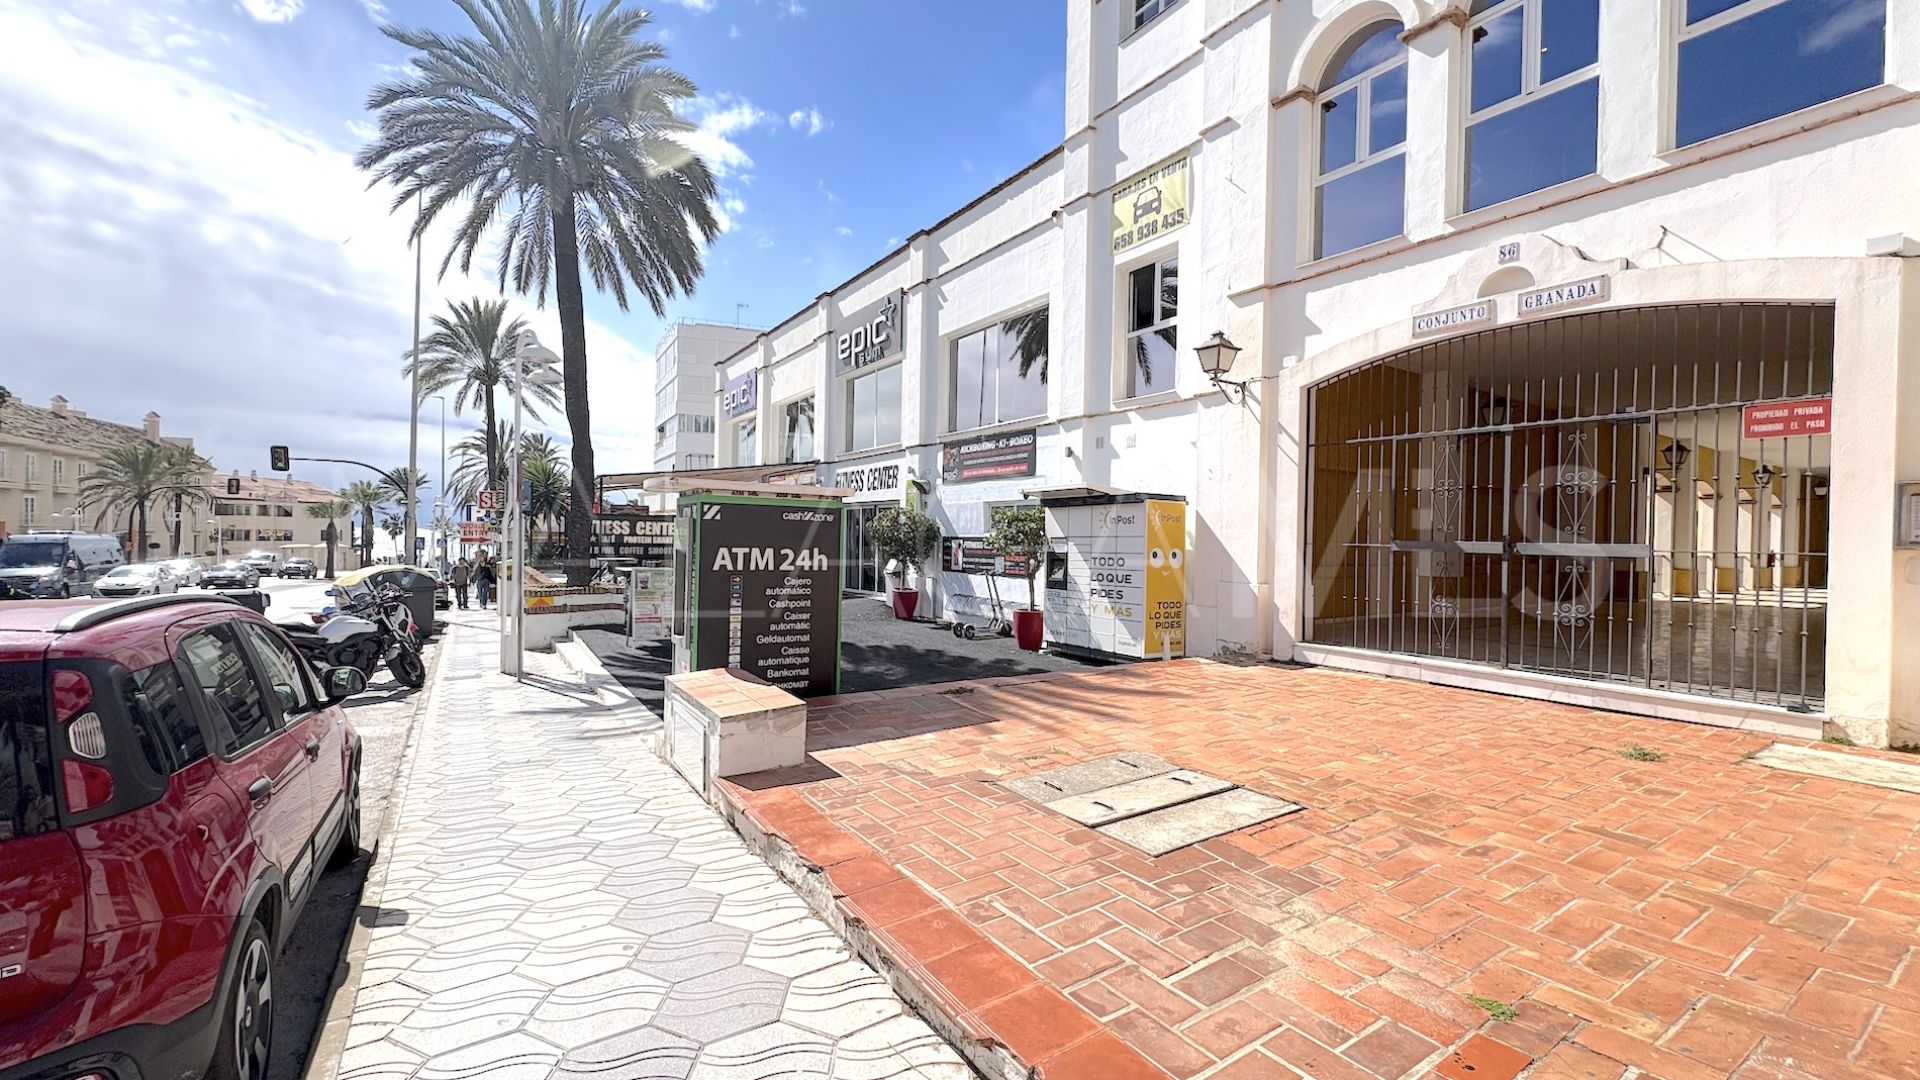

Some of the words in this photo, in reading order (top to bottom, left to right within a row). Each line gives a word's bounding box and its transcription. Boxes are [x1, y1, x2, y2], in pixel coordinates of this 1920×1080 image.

[1114, 230, 1134, 251] 658
[1137, 220, 1158, 241] 938
[1161, 208, 1184, 230] 435
[1499, 244, 1517, 259] 86
[1418, 305, 1486, 330] CONJUNTO
[1525, 282, 1598, 309] GRANADA
[1752, 408, 1789, 419] PROPIEDAD
[1794, 406, 1824, 416] PRIVADA
[1790, 421, 1799, 430] EL
[1806, 419, 1826, 429] PASO
[867, 464, 899, 492] CENTER
[619, 547, 644, 555] COFFEE
[711, 547, 775, 572] ATM
[779, 547, 828, 571] 24h
[1091, 557, 1126, 567] TODO
[784, 577, 812, 589] Cajero
[1091, 589, 1124, 600] PIDES
[768, 599, 811, 610] Cashpoint
[1157, 601, 1182, 610] TODO
[783, 611, 811, 621] Caixer
[1163, 611, 1182, 619] QUE
[1155, 621, 1182, 629] PIDES
[756, 634, 810, 645] Geldautomat
[781, 646, 810, 655] Caisse
[757, 656, 810, 667] automatique
[767, 668, 810, 678] Bankomat
